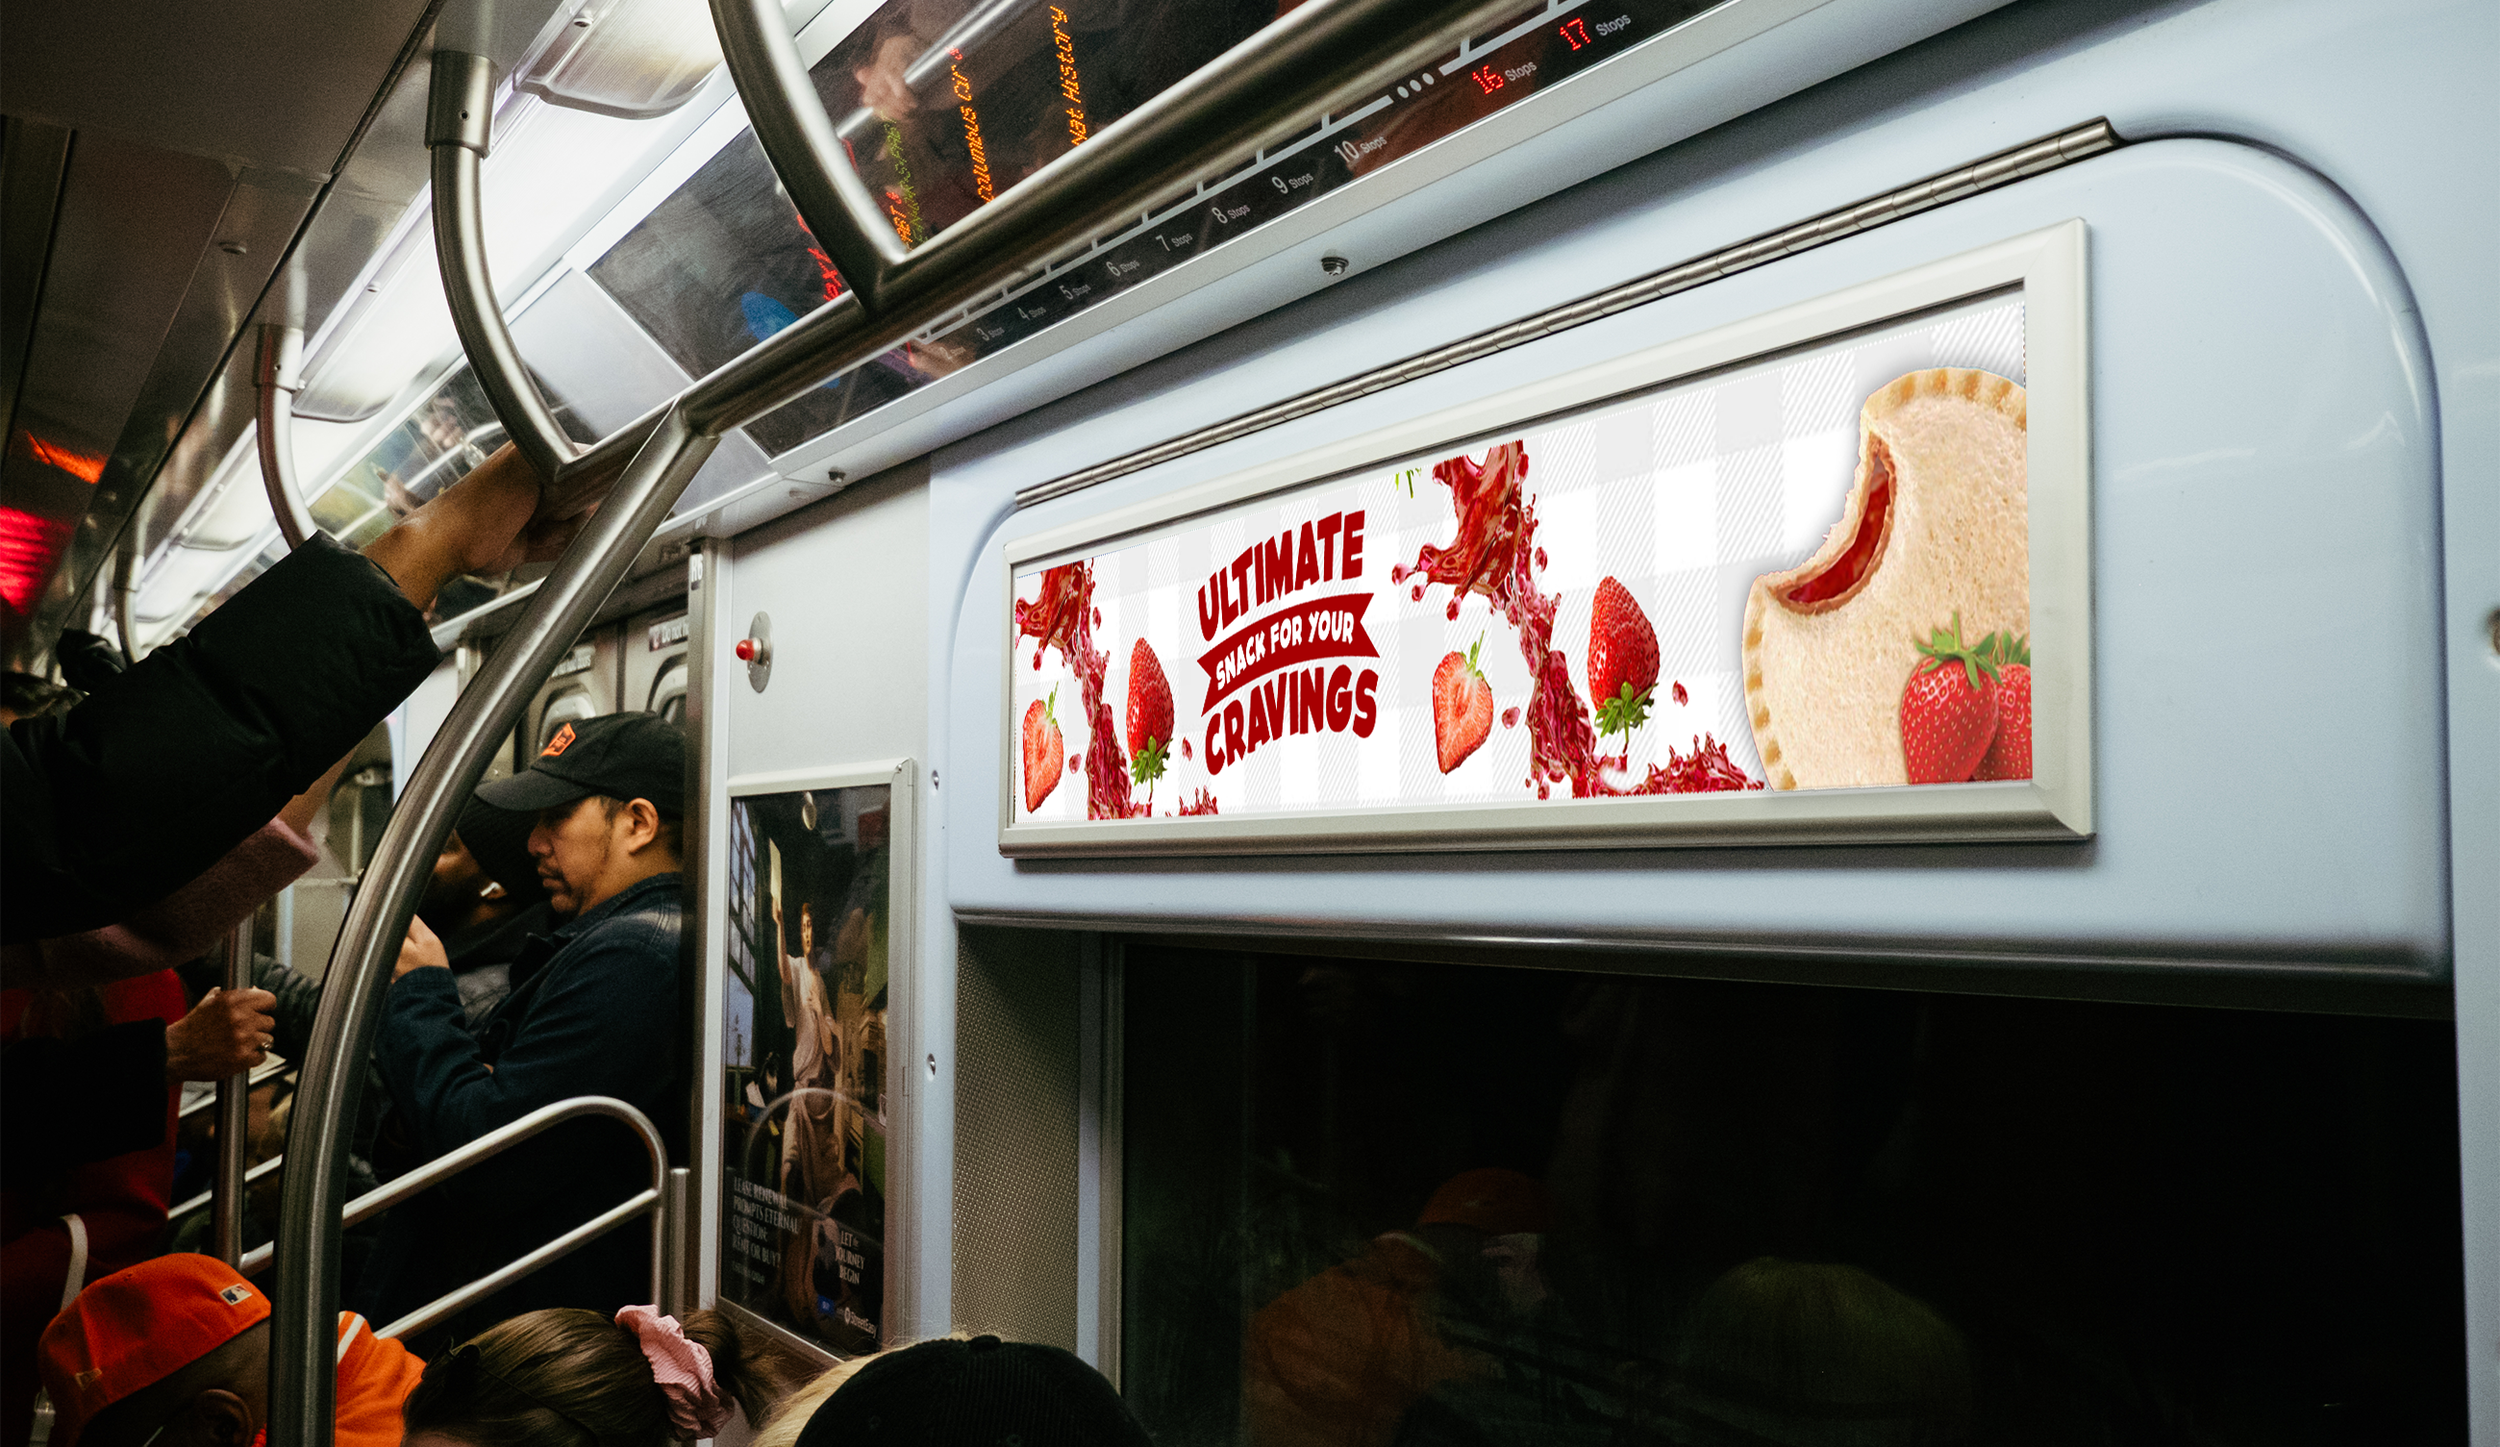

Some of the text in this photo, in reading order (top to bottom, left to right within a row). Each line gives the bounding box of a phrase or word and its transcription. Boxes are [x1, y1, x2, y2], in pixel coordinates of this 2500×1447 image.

[1559, 13, 1631, 51] 17 Stops
[1050, 5, 1088, 147] Nat History
[1472, 60, 1537, 95] 16 Stops
[960, 105, 996, 203] Columbus
[1334, 135, 1387, 163] 10 Stops
[1271, 172, 1314, 194] 9 Stops
[1211, 204, 1251, 224] 8 Stops
[1156, 232, 1193, 251] 7 Stops
[1106, 259, 1140, 278] 6 Stops
[1059, 285, 1074, 300] 5
[1017, 307, 1031, 321] 4
[976, 327, 990, 341] 3
[1198, 510, 1365, 642] ULTIMATE
[1215, 609, 1355, 691] SNACK FOR YOUR
[1205, 664, 1379, 776] CRAVINGS
[764, 1207, 799, 1235] ETERNAL
